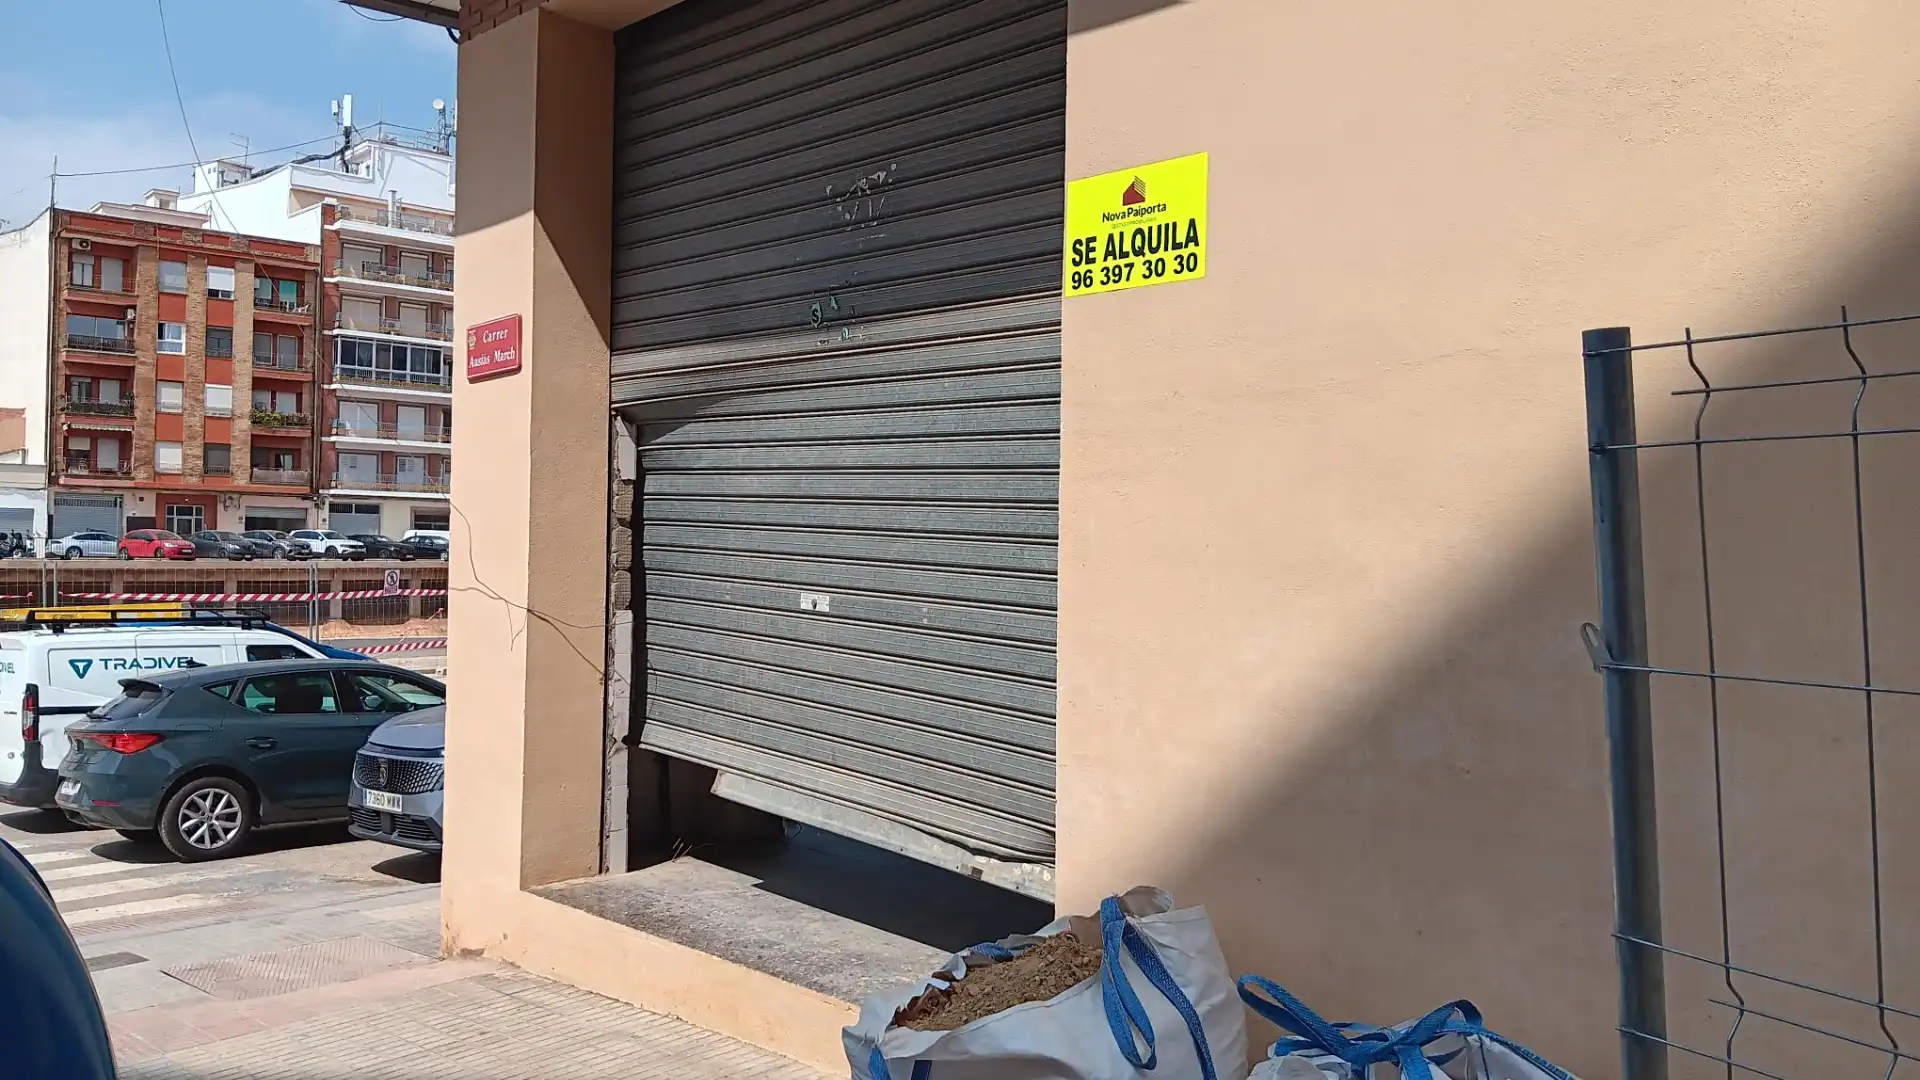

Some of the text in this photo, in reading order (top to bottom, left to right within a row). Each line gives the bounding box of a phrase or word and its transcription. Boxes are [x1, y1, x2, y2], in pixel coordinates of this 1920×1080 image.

[1071, 217, 1200, 267] SE ALQUILA
[1071, 251, 1198, 290] 96 397 30 30
[482, 328, 509, 344] Carrer
[494, 345, 516, 363] March
